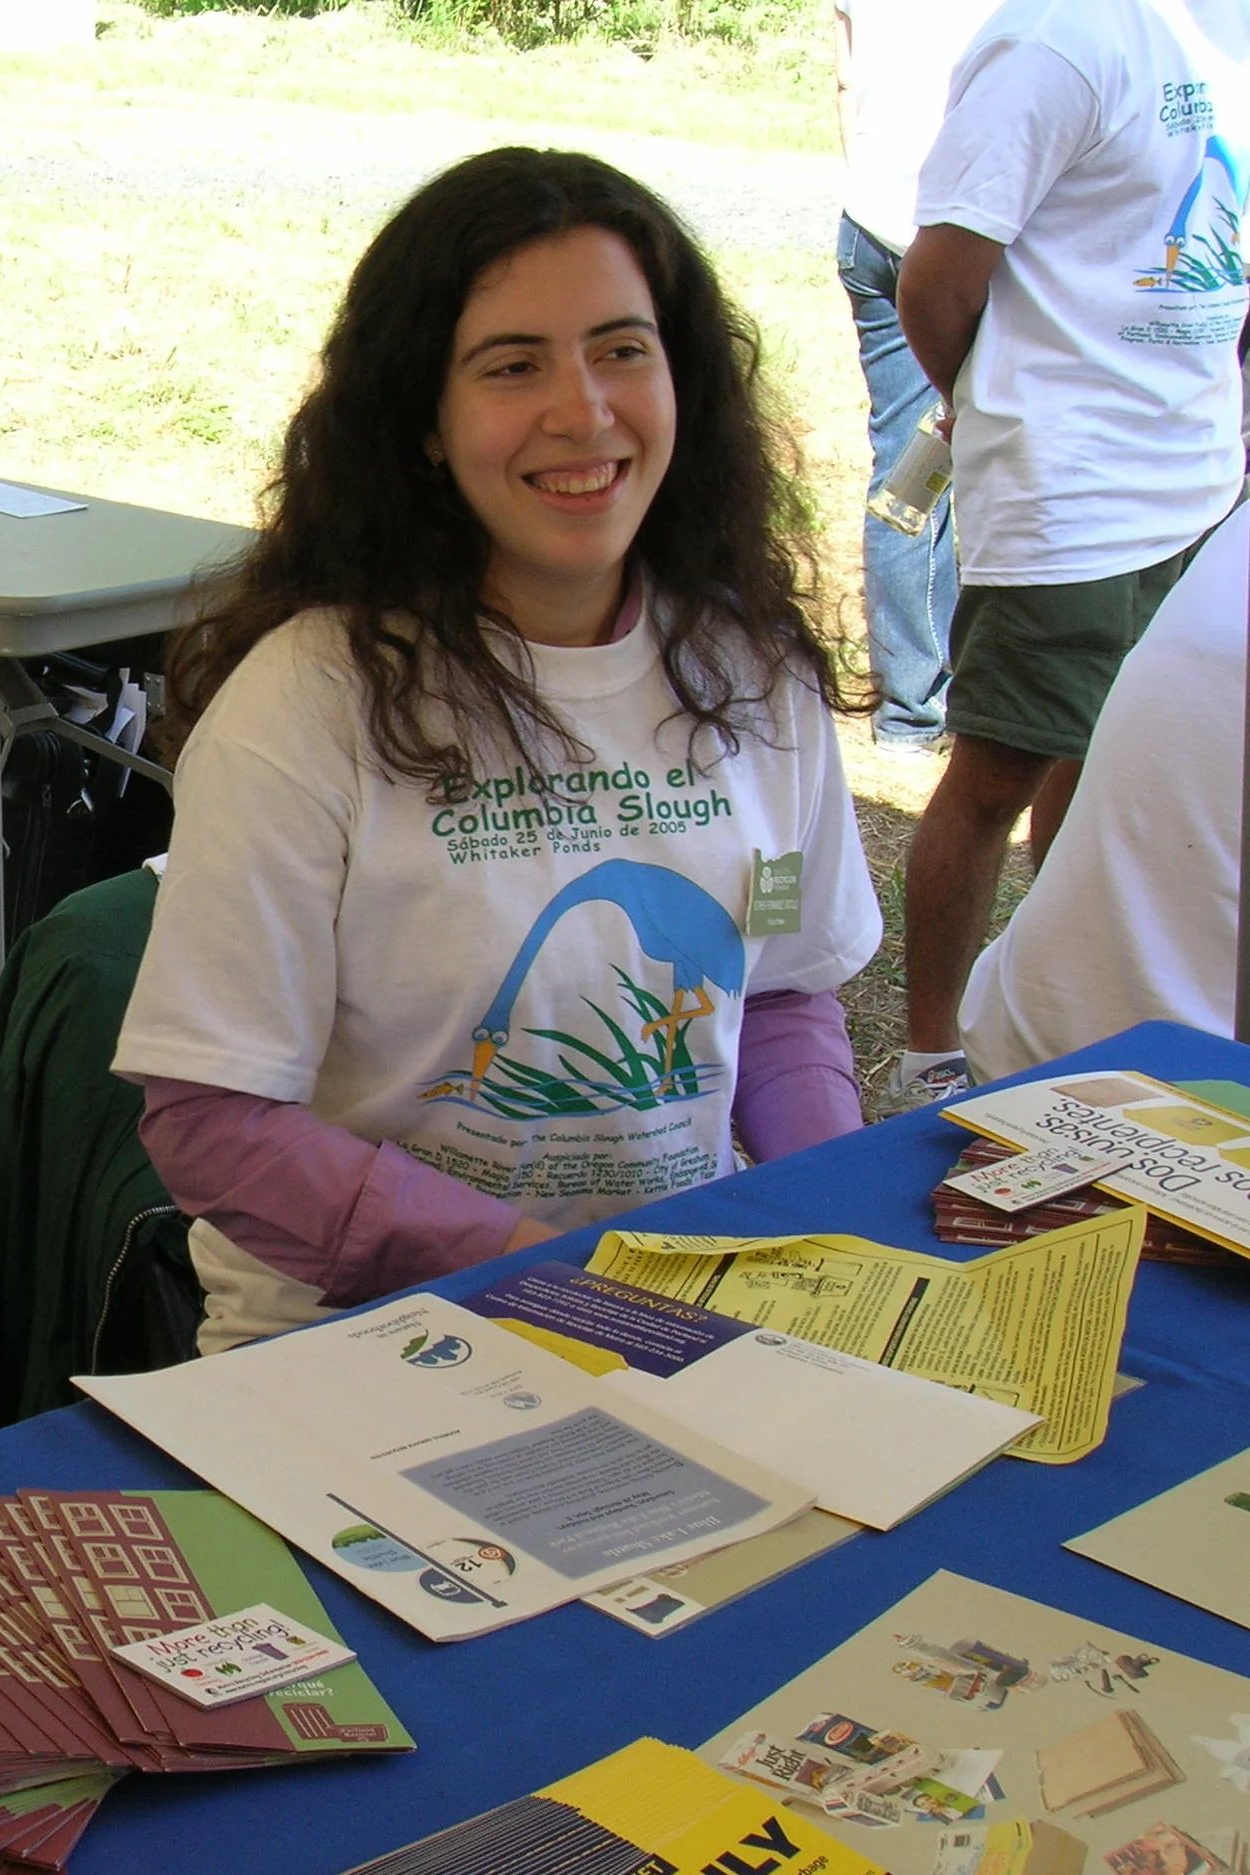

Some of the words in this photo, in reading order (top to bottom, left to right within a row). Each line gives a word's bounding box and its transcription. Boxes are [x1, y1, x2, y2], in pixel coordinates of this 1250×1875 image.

[441, 761, 651, 808] Explorando
[666, 759, 696, 788] el
[431, 802, 598, 838] Columbia
[617, 790, 733, 826] Slough
[446, 834, 509, 852] Sábado
[516, 829, 538, 844] 25
[546, 826, 565, 842] de
[570, 825, 613, 841] Junio
[619, 822, 641, 837] de
[648, 820, 687, 835] 2005
[449, 845, 542, 865] Whitaker
[552, 840, 601, 854] Ponds
[969, 1163, 1021, 1183] More
[1019, 1147, 1060, 1164] than
[1130, 1157, 1201, 1193] Dos
[970, 1174, 1008, 1194] just
[570, 1277, 708, 1323] ¿PREGUNTAS?
[457, 1558, 483, 1572] 12
[146, 1633, 210, 1656] More
[208, 1617, 259, 1639] than
[150, 1652, 197, 1673] just
[198, 1618, 291, 1658] recycling!
[269, 1688, 334, 1697] reciclar?
[754, 1744, 786, 1769] Just
[771, 1748, 807, 1782] Right
